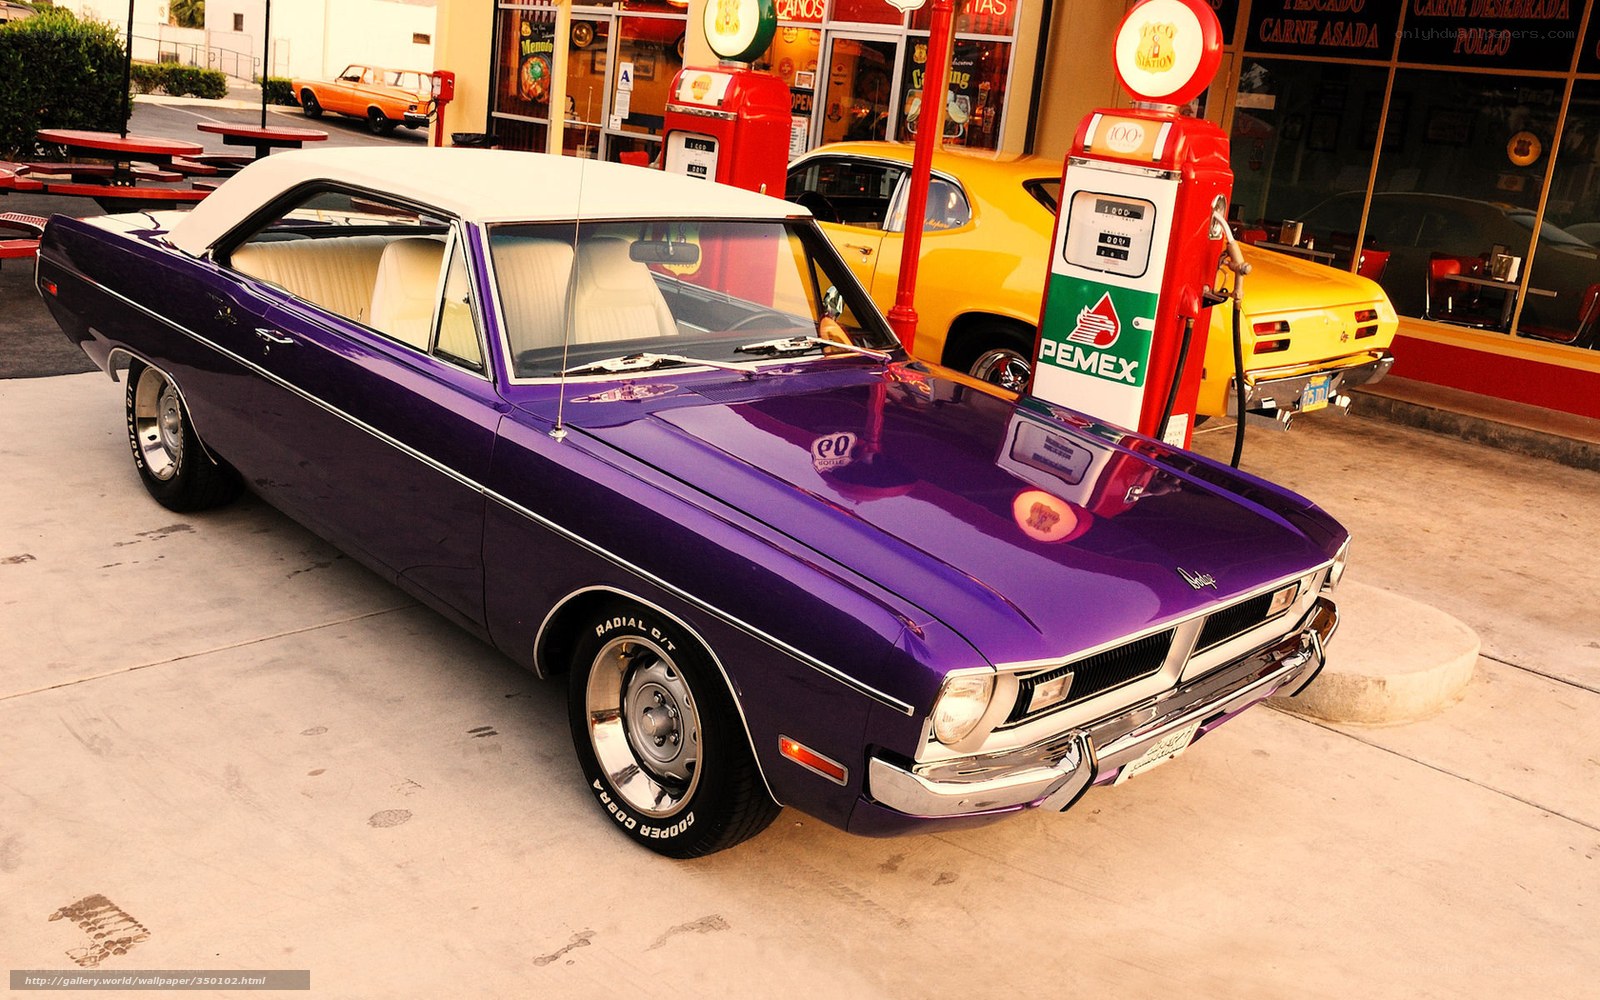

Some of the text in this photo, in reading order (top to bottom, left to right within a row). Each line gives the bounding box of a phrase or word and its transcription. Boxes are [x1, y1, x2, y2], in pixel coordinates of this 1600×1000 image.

[1143, 24, 1173, 39] TACO
[1259, 18, 1379, 48] CARNE ASADA
[1453, 27, 1511, 55] POLLO
[1136, 51, 1172, 68] STATION
[621, 69, 630, 82] A
[1039, 338, 1139, 384] PEMEX
[595, 616, 676, 651] RADIAL G/T
[593, 778, 695, 839] COOPER COBRA
